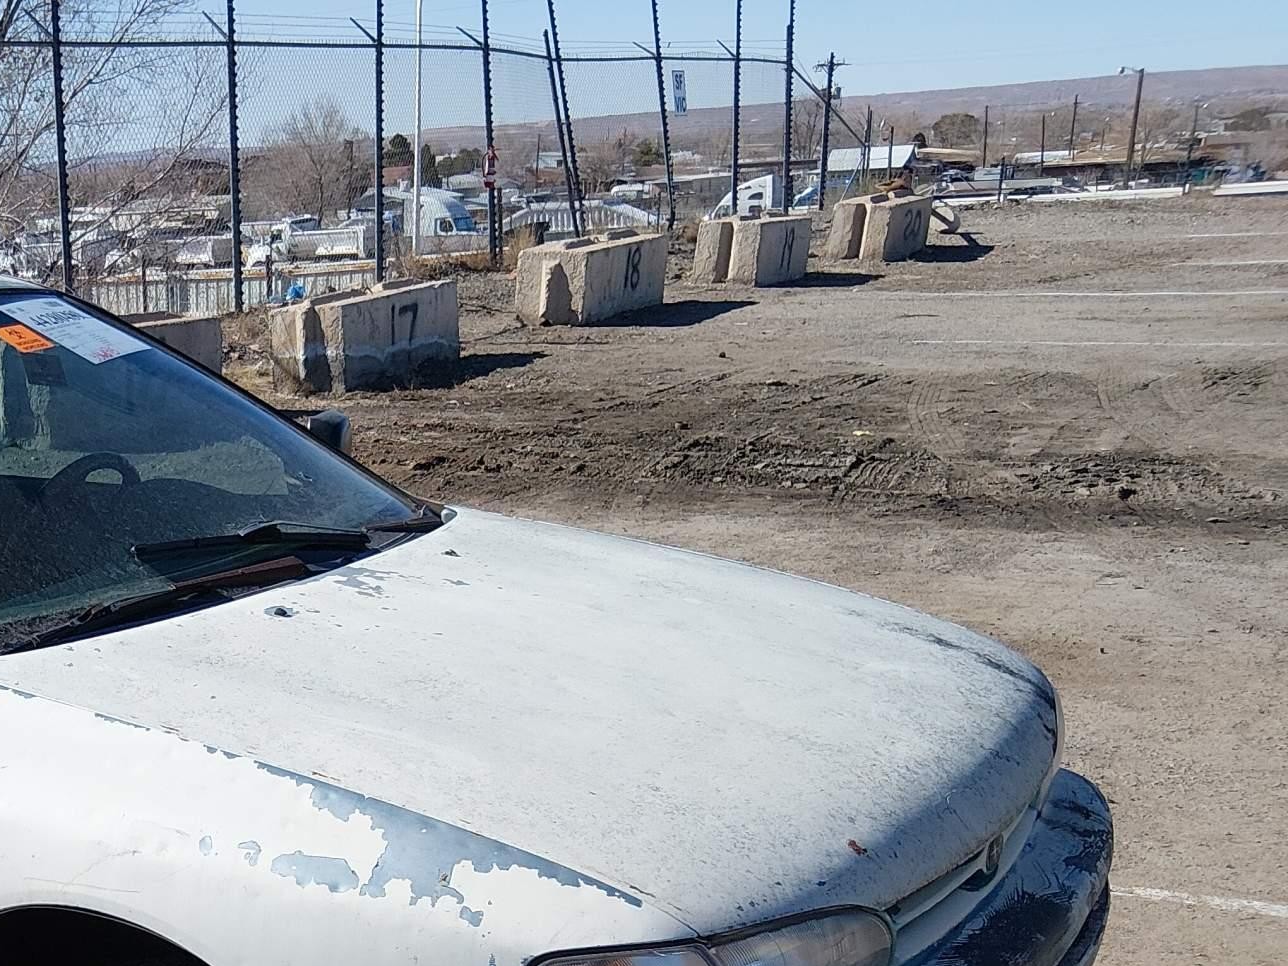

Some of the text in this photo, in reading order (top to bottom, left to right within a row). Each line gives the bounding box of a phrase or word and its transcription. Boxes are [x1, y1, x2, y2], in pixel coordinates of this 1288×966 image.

[903, 209, 922, 241] 20
[624, 247, 642, 290] 18
[390, 303, 419, 346] 17
